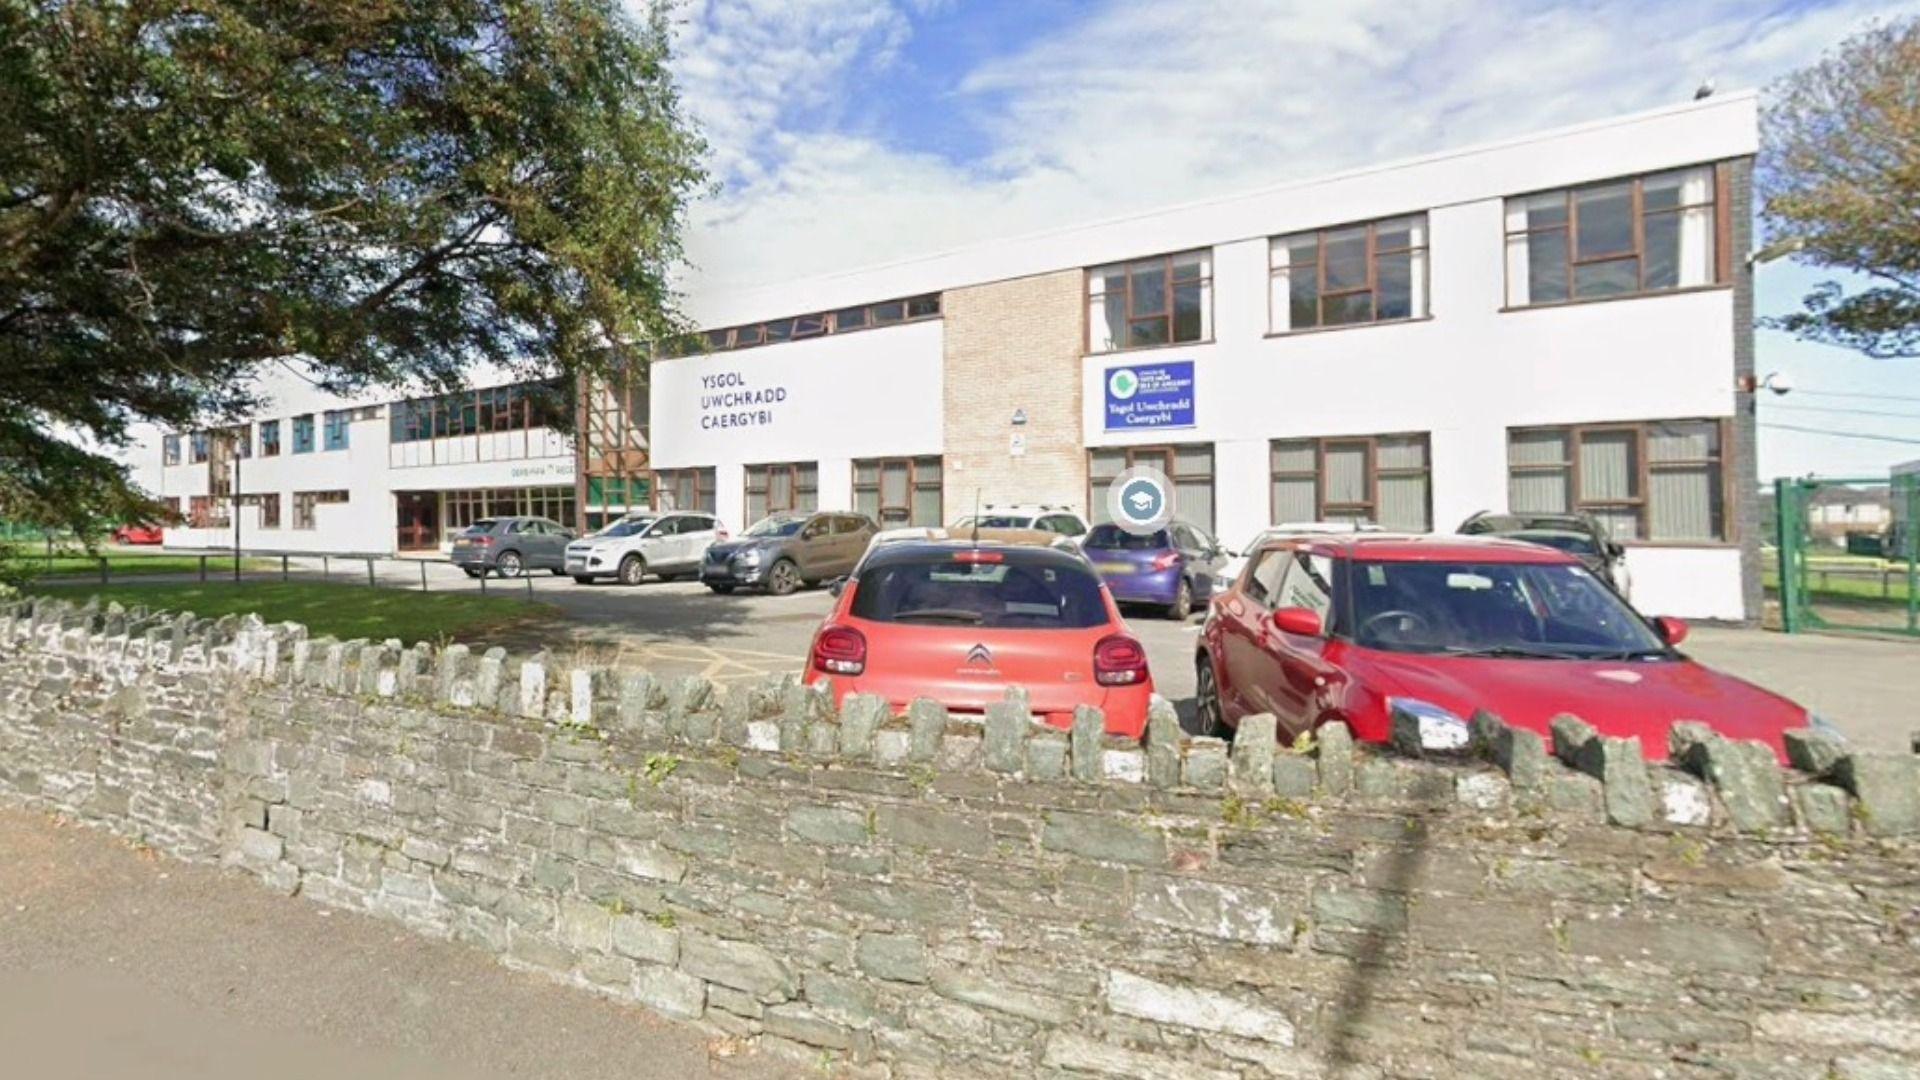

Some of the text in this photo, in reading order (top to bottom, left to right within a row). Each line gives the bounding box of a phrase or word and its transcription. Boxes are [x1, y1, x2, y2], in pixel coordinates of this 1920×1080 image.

[701, 372, 745, 389] YSGOL
[701, 387, 786, 409] UWCHRADD
[1136, 398, 1190, 411] Uwchradd
[701, 410, 772, 429] CAERGYBI
[1126, 411, 1171, 425] Caergybi
